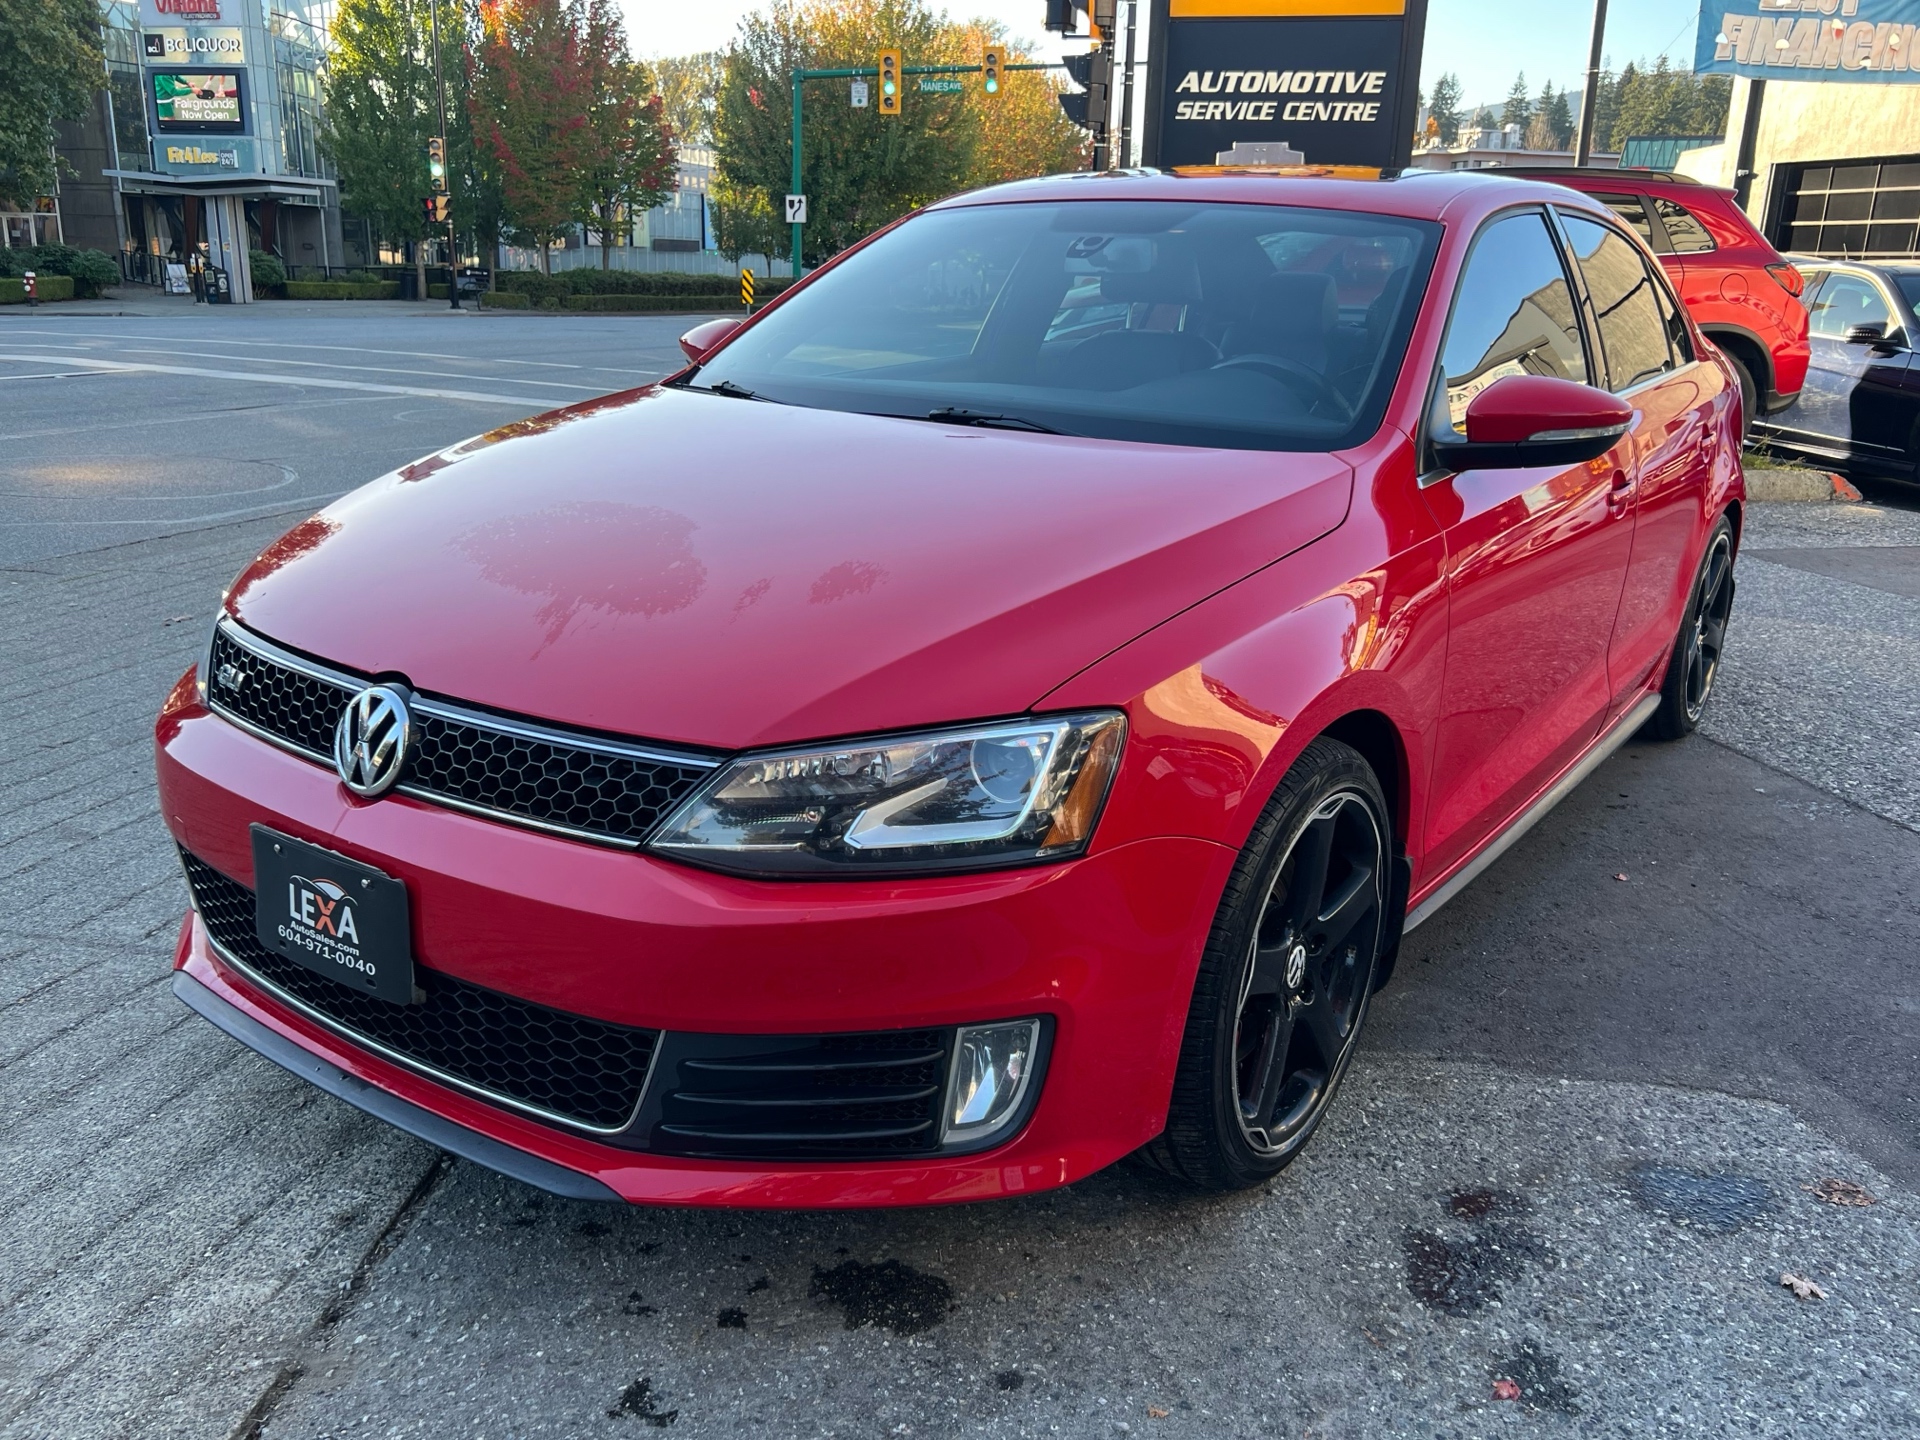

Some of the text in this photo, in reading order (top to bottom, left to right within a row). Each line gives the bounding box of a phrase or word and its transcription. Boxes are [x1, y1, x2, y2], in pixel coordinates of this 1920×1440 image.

[920, 81, 962, 92] HANES AVE
[1175, 71, 1387, 94] AUTOMOTIVE
[175, 98, 236, 111] Fairgrounds
[1175, 101, 1381, 121] SERVICE CENTRE
[181, 110, 229, 121] Now Open
[289, 882, 359, 945] LEXA
[290, 920, 359, 956] AutoSales.com
[278, 924, 376, 976] 604-971-0040
